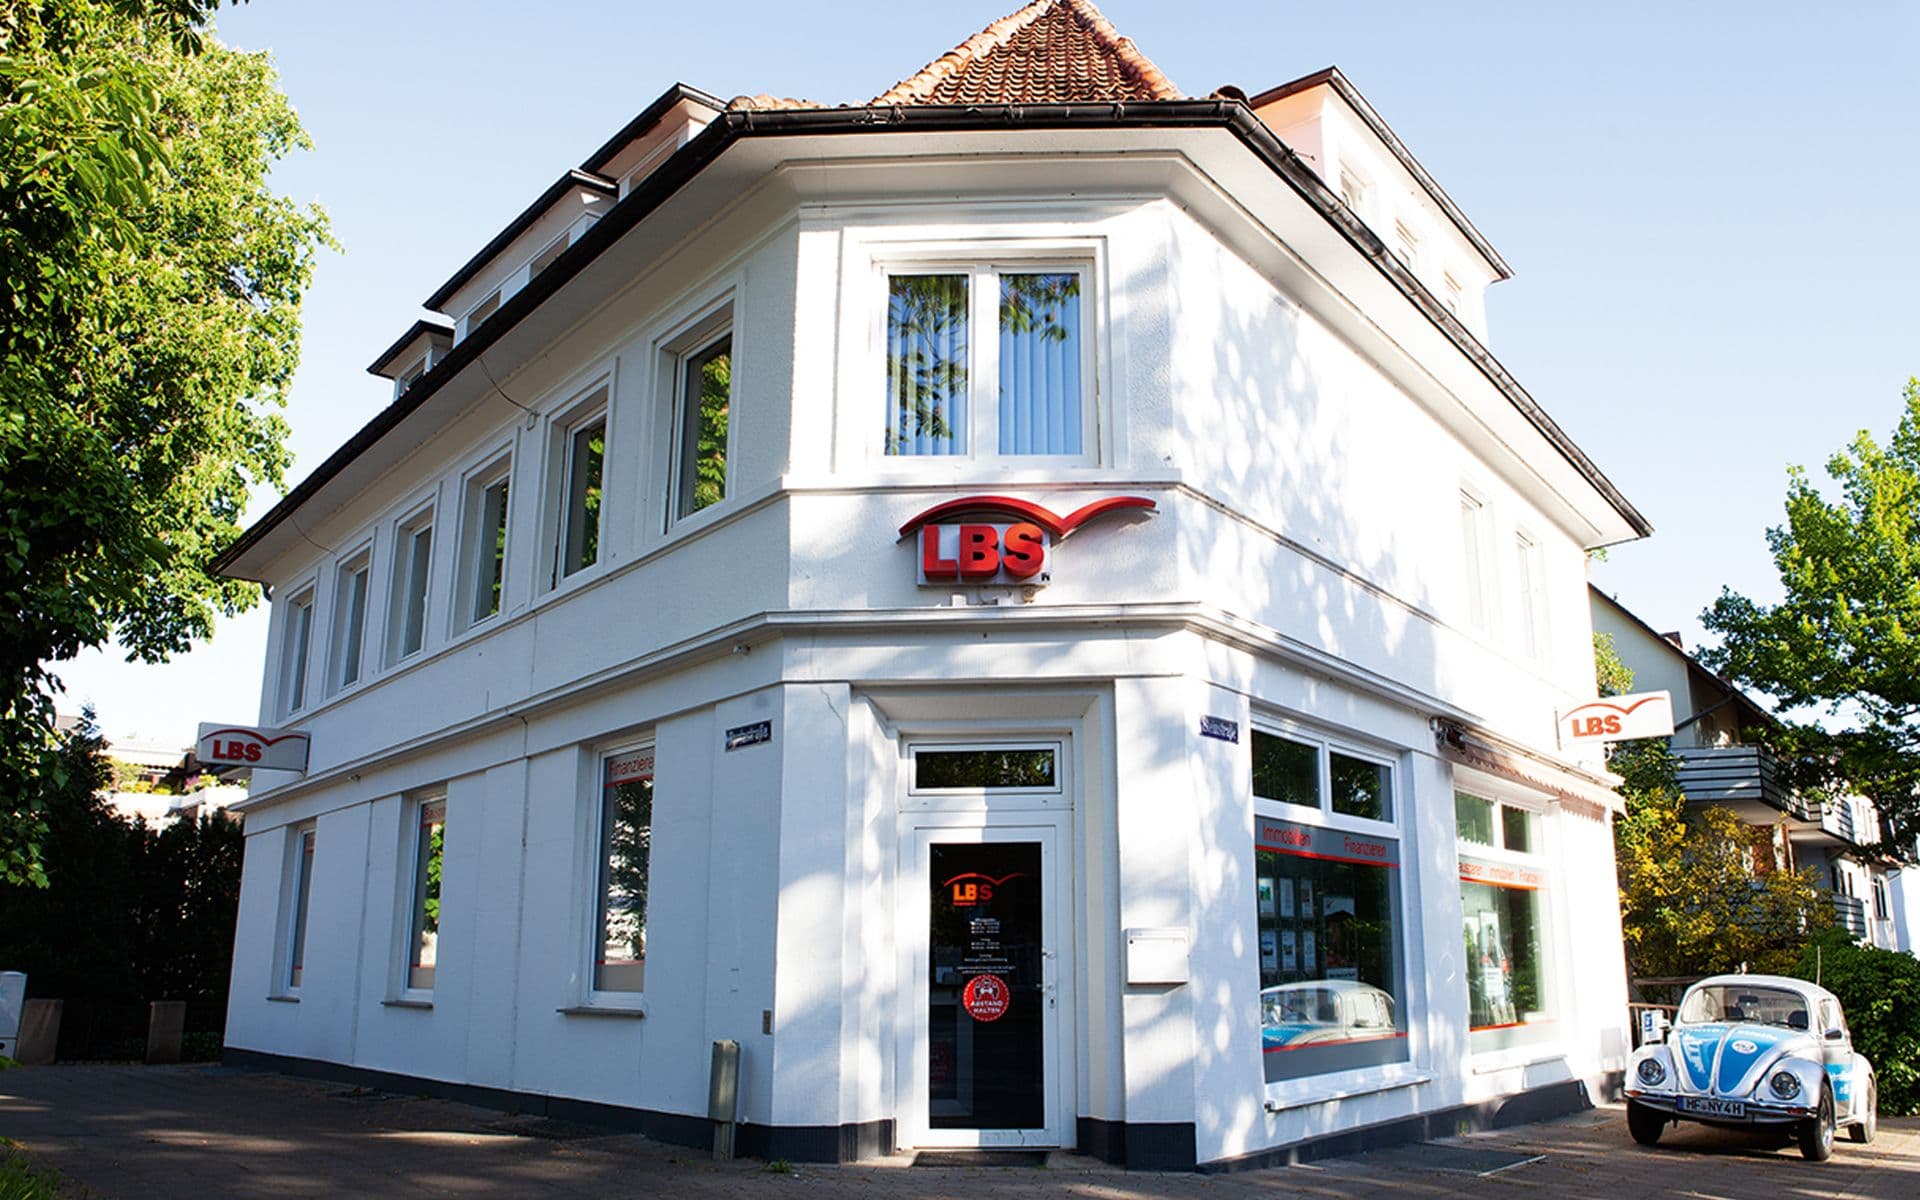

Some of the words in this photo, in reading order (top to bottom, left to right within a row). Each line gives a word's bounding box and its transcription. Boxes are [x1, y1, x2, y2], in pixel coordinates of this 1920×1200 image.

[923, 522, 1044, 577] LBS
[1572, 714, 1622, 737] LBS
[212, 740, 262, 762] LBS
[608, 756, 654, 776] Finanziere
[953, 884, 993, 901] LBS
